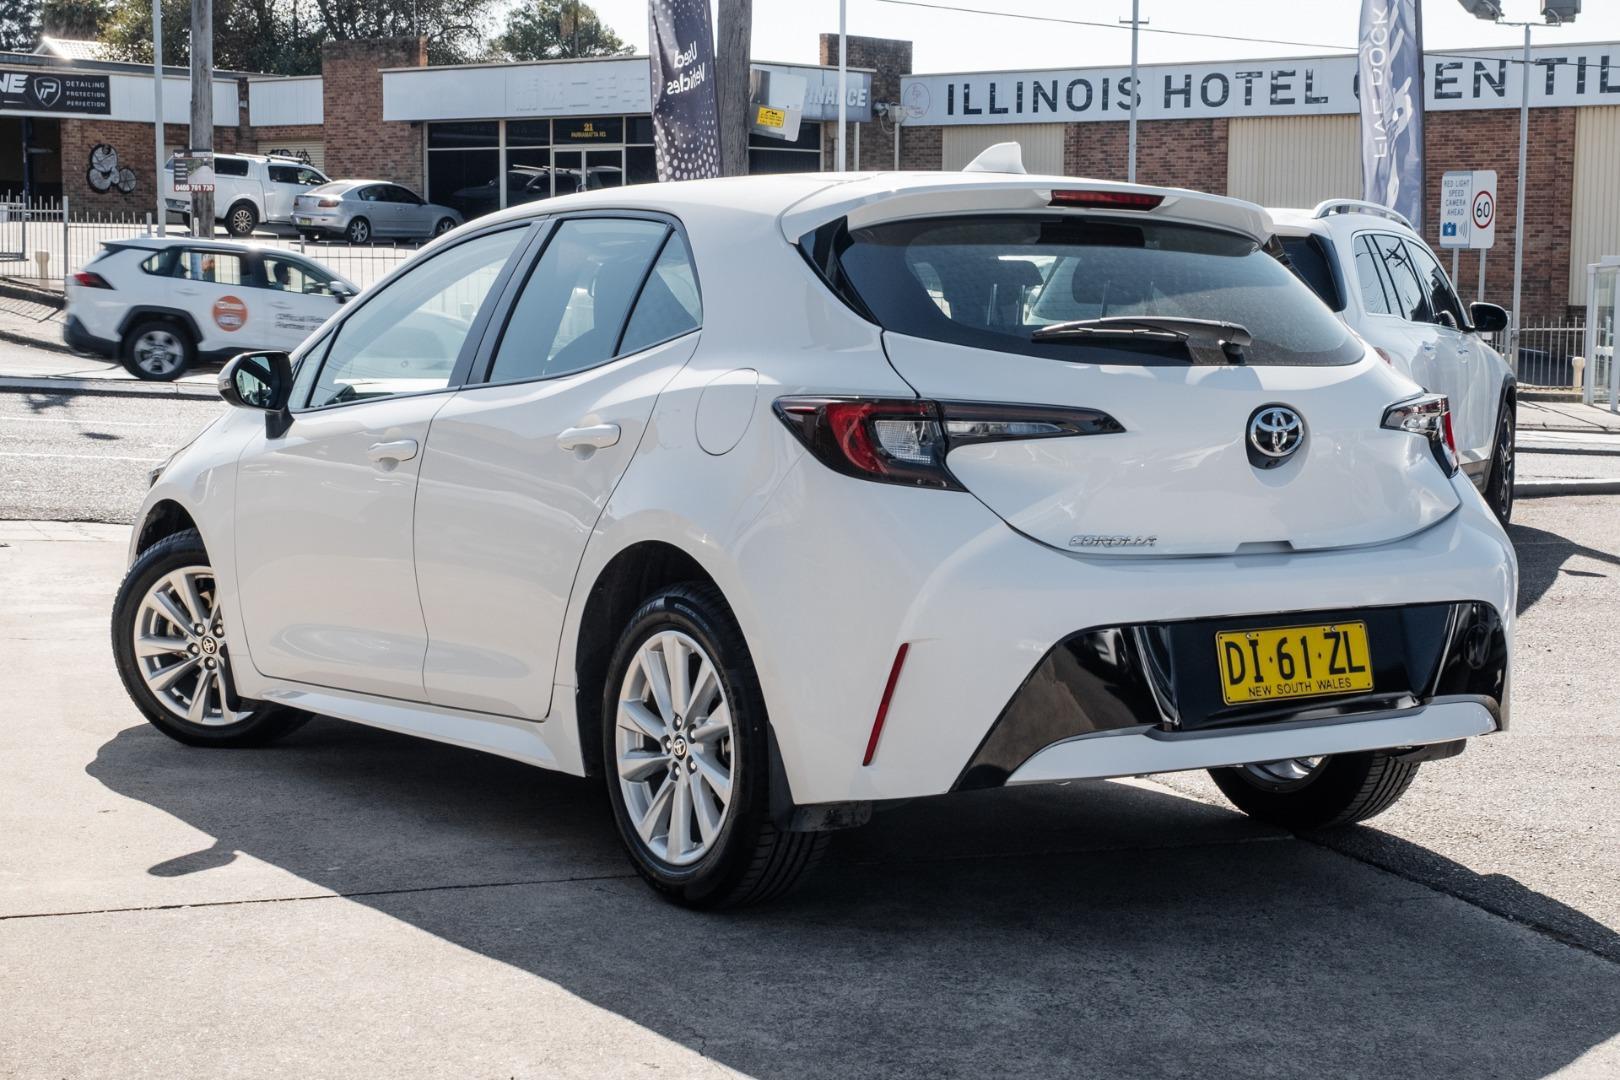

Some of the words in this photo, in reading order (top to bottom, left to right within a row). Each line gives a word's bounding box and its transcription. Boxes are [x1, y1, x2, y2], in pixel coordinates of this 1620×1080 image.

[65, 80, 105, 88] DETAILING
[947, 76, 1142, 115] ILLINOIS
[1163, 68, 1329, 109] HOTEL
[583, 122, 593, 131] 21
[1444, 179, 1454, 187] RED
[1455, 179, 1470, 187] LIGHT
[1448, 189, 1464, 197] SPEED
[1445, 199, 1466, 207] CAMERA
[1447, 208, 1464, 216] AHEAD
[1476, 201, 1490, 218] 60
[1068, 534, 1158, 548] COROLLA
[1248, 683, 1272, 697] NEW
[1276, 681, 1312, 696] SOUTH
[1316, 677, 1352, 691] WALES
